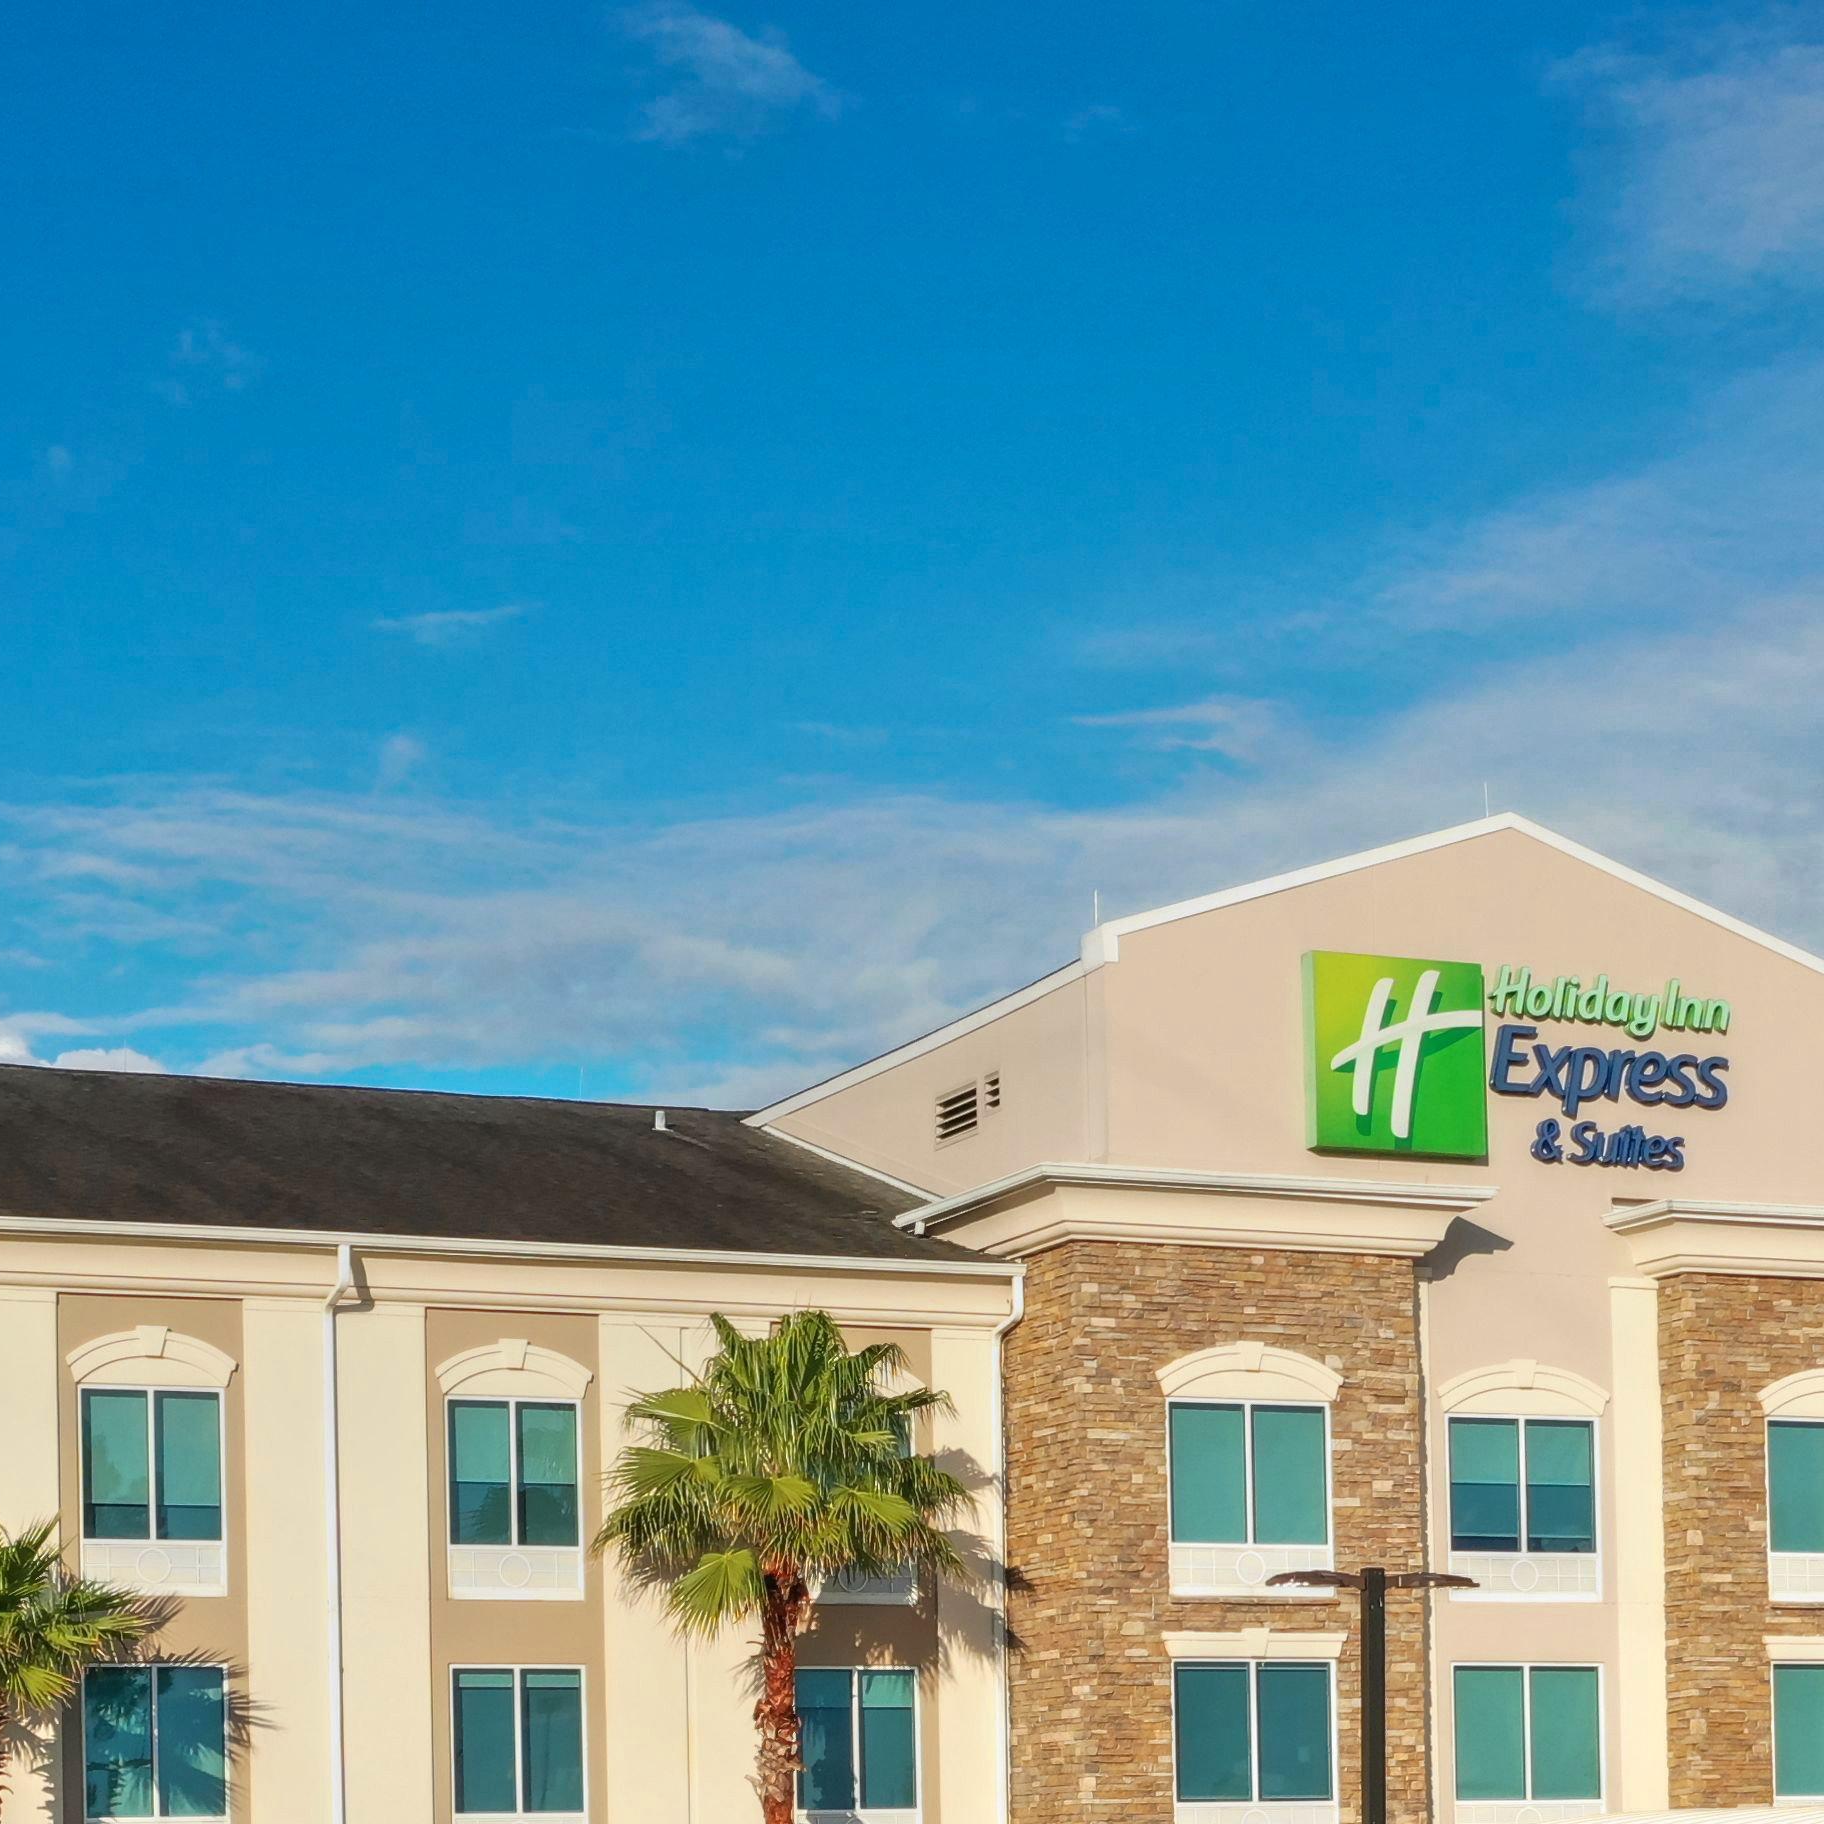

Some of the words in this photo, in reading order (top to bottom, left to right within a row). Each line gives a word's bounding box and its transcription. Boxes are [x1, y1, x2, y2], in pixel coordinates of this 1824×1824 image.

[1488, 964, 1660, 1040] Holiday
[1660, 977, 1731, 1035] Inn
[1488, 1023, 1731, 1119] Express
[1530, 1117, 1564, 1163] &
[1567, 1119, 1686, 1172] Suites
